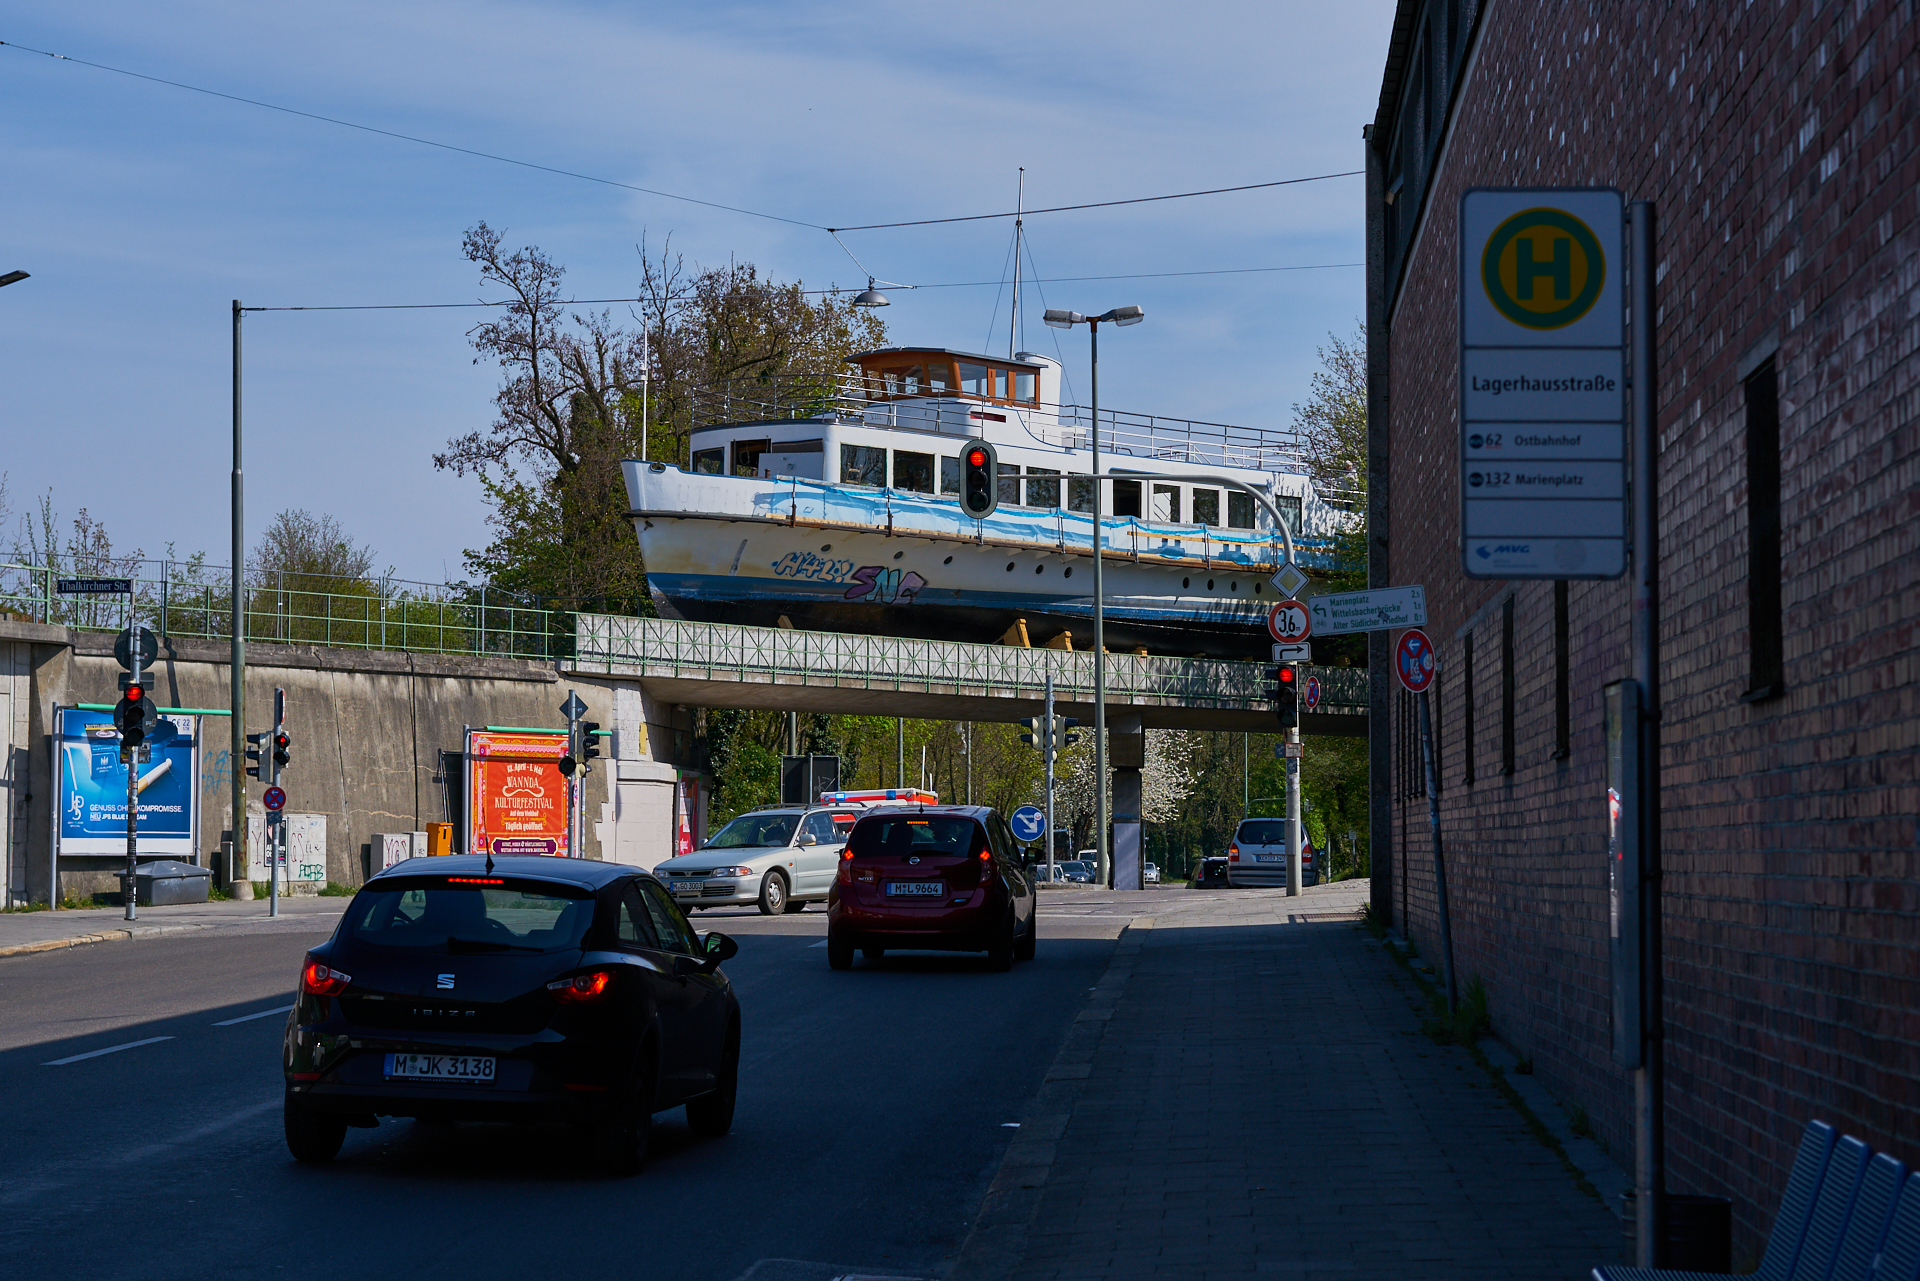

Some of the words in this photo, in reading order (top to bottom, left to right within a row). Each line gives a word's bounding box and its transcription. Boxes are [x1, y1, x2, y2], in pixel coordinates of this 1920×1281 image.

[1516, 238, 1571, 300] H
[1471, 374, 1616, 396] Lagerhausstraße
[1485, 433, 1503, 447] 62
[1514, 434, 1582, 447] Ostbahnhof
[1485, 472, 1511, 485] 132
[1515, 473, 1584, 487] Marienplatz
[61, 580, 112, 591] Thalkirchner
[114, 581, 127, 591] Str.
[1329, 595, 1370, 607] Marienplatz
[1331, 604, 1401, 619] Wittelsbacherbrücke
[1333, 620, 1348, 631] Alter
[1350, 617, 1380, 630] Südlicher
[182, 718, 190, 727] 22
[506, 776, 539, 789] WANNDA
[90, 804, 116, 812] GENUSS
[137, 804, 183, 813] KOMPROMISSE.
[494, 797, 554, 809] KULTURFESTIVAL
[90, 812, 101, 821] NEU
[505, 822, 522, 832] Täglich
[895, 884, 902, 893] M
[907, 884, 914, 893] L
[915, 884, 939, 893] 9664
[413, 1008, 476, 1017] IBIZA
[394, 1055, 408, 1074] M
[418, 1056, 443, 1075] JK
[447, 1058, 494, 1077] 3138
